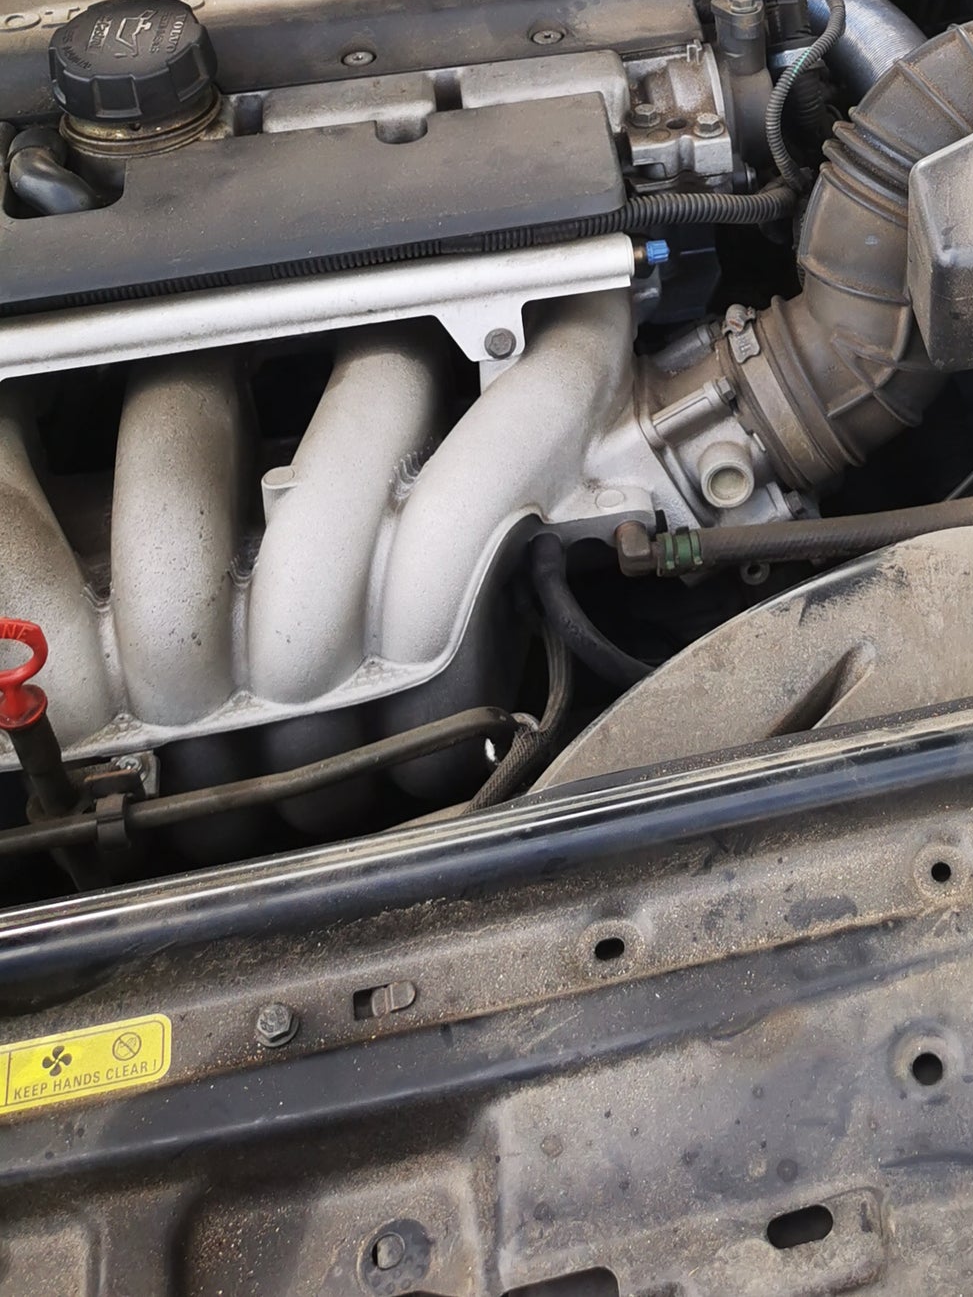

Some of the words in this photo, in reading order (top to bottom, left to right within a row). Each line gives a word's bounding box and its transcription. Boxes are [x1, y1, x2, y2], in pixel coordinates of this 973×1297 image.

[166, 13, 187, 54] VOLVO
[14, 1082, 48, 1100] KEEP
[53, 1071, 100, 1092] HANDS
[106, 1060, 148, 1080] CLEAR
